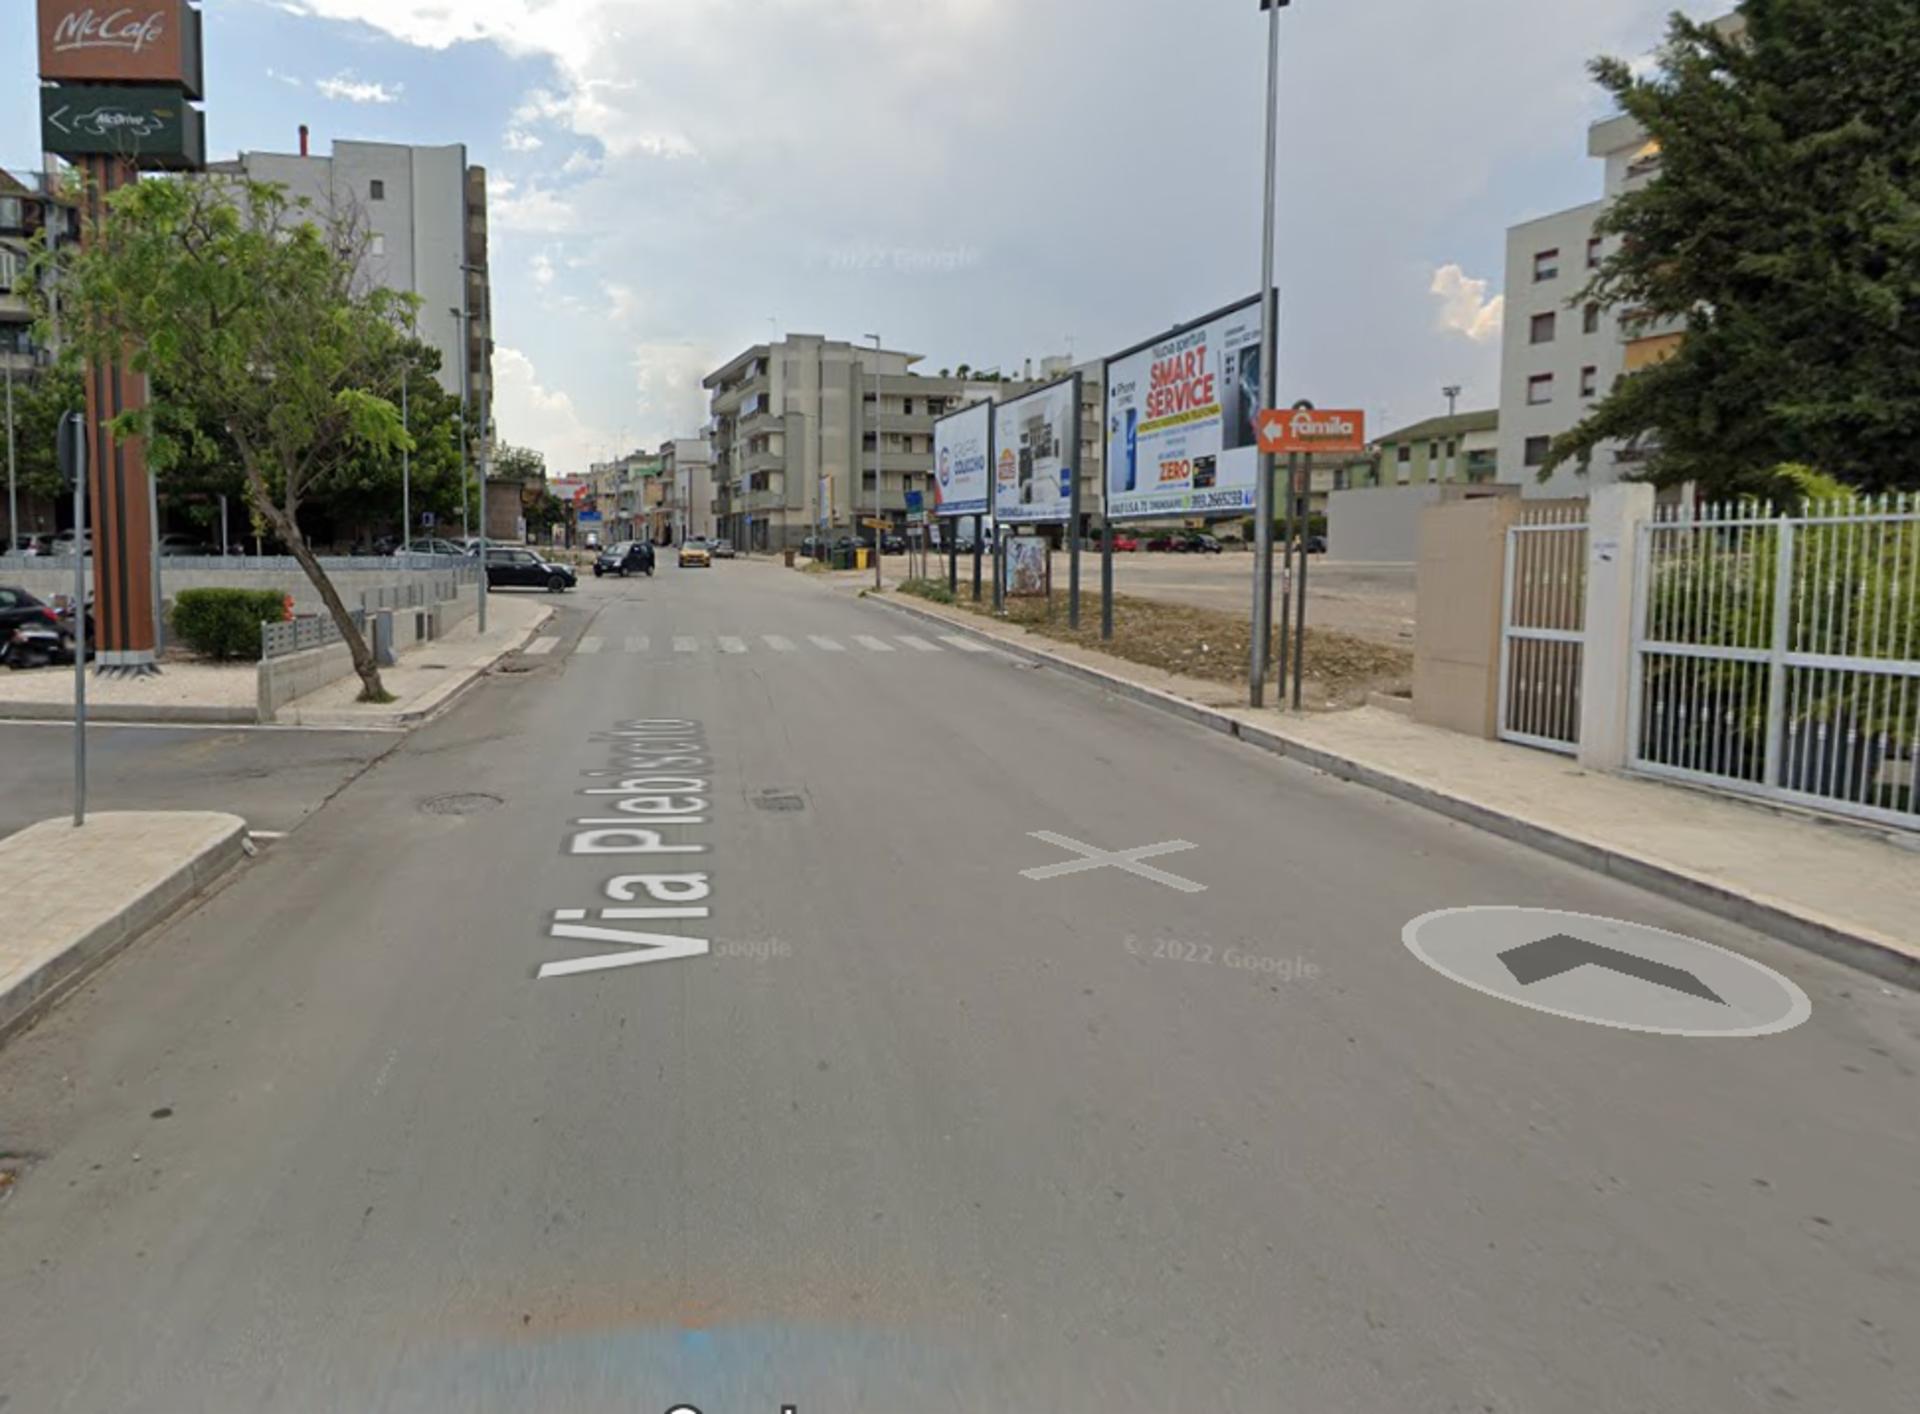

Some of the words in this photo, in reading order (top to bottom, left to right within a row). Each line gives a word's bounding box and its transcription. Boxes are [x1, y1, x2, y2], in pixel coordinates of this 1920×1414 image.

[1150, 344, 1207, 390] SMART
[1145, 373, 1215, 420] SERVICE
[1159, 459, 1191, 482] ZERO
